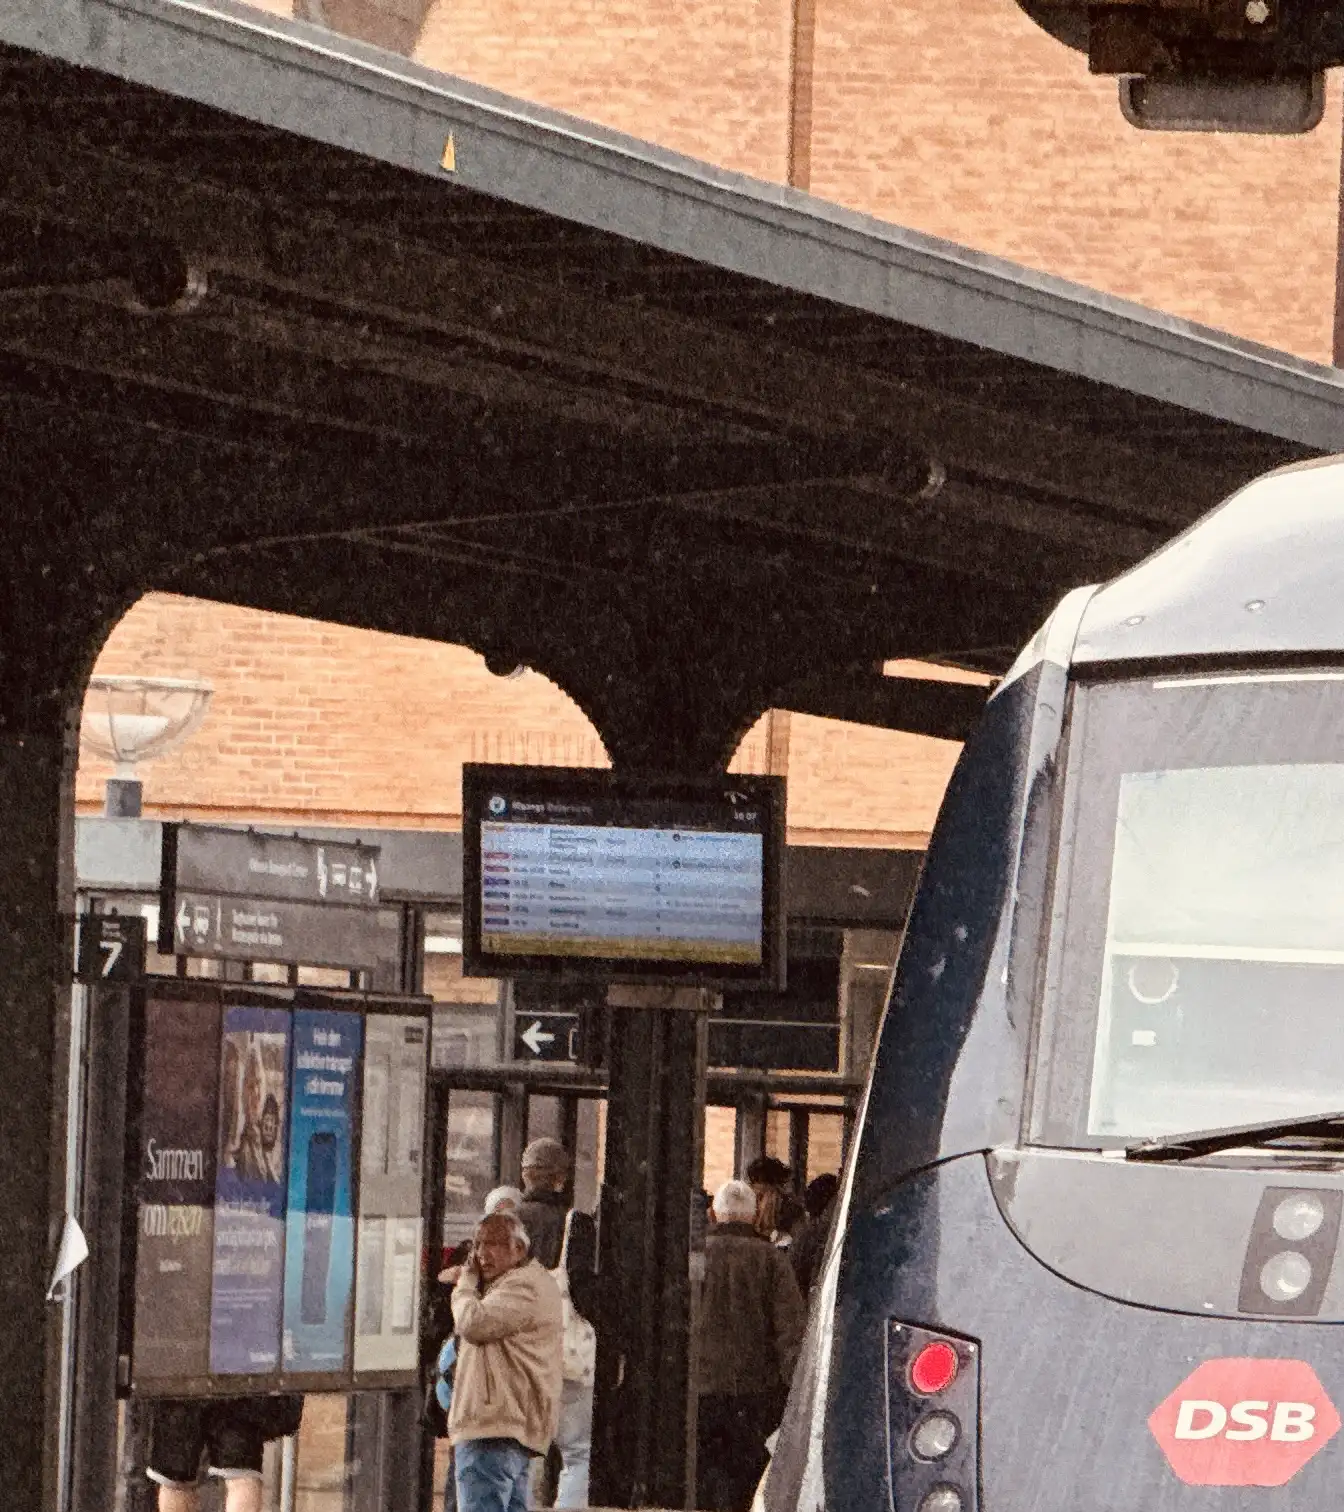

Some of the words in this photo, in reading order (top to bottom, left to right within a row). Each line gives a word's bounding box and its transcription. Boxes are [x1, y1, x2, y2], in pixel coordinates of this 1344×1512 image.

[99, 940, 123, 977] 7
[145, 1138, 204, 1181] Sammen
[1174, 1400, 1316, 1442] DSB
